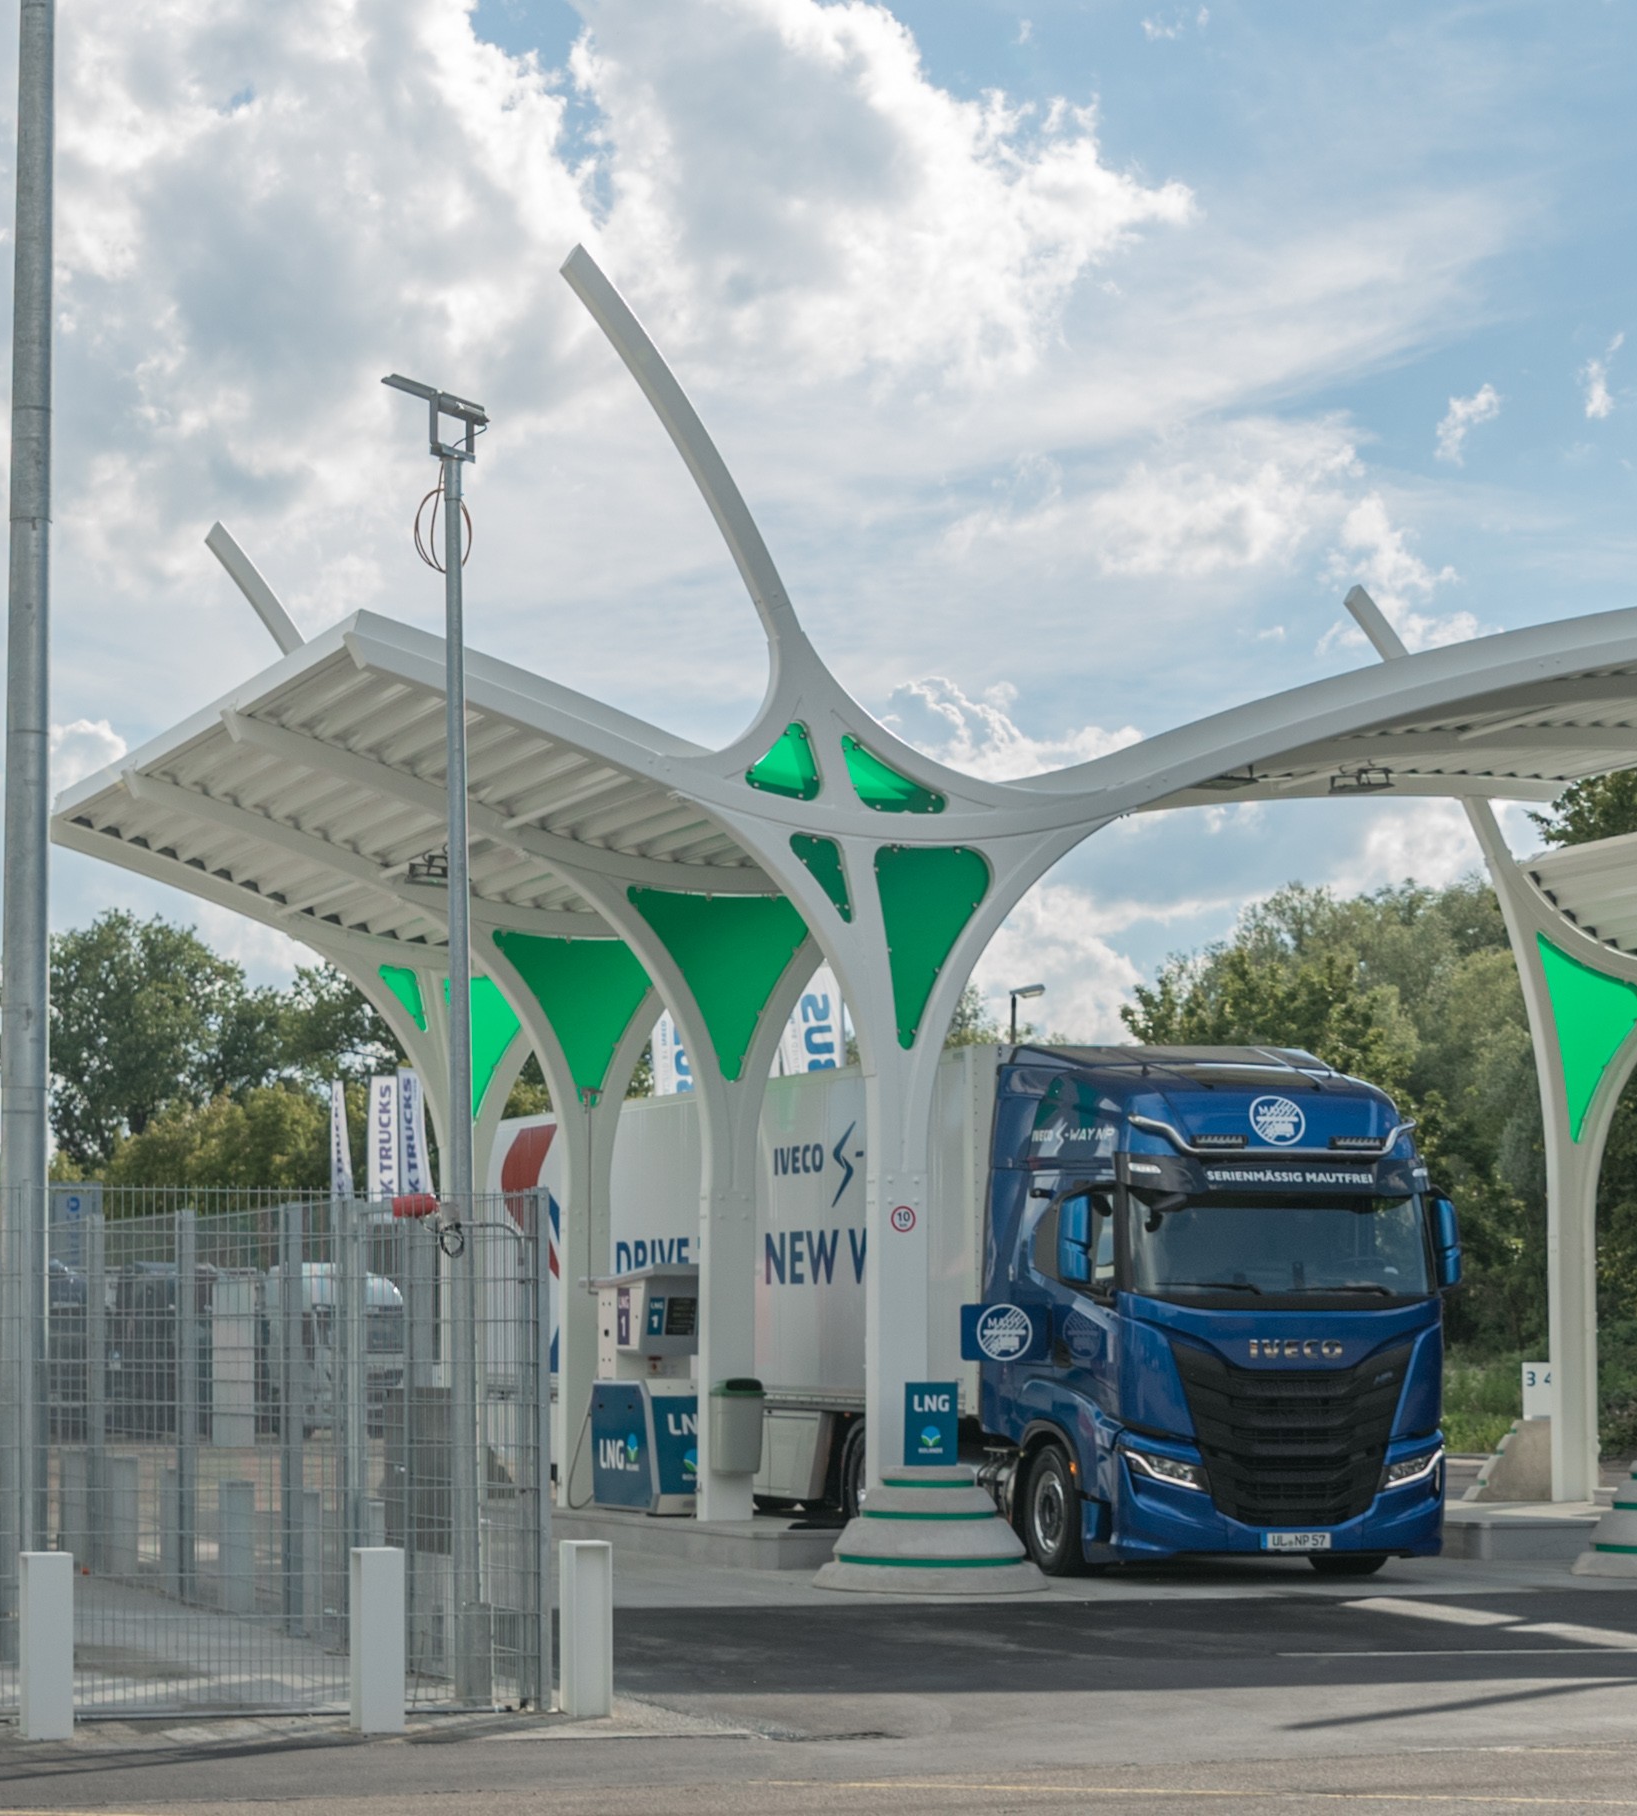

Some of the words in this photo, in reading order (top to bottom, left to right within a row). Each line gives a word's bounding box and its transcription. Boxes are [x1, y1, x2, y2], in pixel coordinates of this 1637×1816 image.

[378, 1084, 393, 1174] TRUCKS
[403, 1077, 419, 1173] TRUCKS
[773, 1143, 824, 1176] IVECO
[1206, 1169, 1303, 1183] SERIENMÄSSIG
[1305, 1171, 1373, 1184] MAUTFREI
[897, 1211, 911, 1222] 10
[765, 1228, 839, 1285] NEW
[620, 1315, 627, 1338] 1
[651, 1315, 659, 1329] 1
[1249, 1339, 1343, 1359] IVECO
[1526, 1371, 1536, 1387] 3
[913, 1394, 950, 1412] LNG
[667, 1413, 698, 1435] LN
[599, 1438, 624, 1470] LNG
[1272, 1534, 1287, 1547] UL
[1294, 1534, 1309, 1547] NP
[1311, 1534, 1326, 1547] 57
